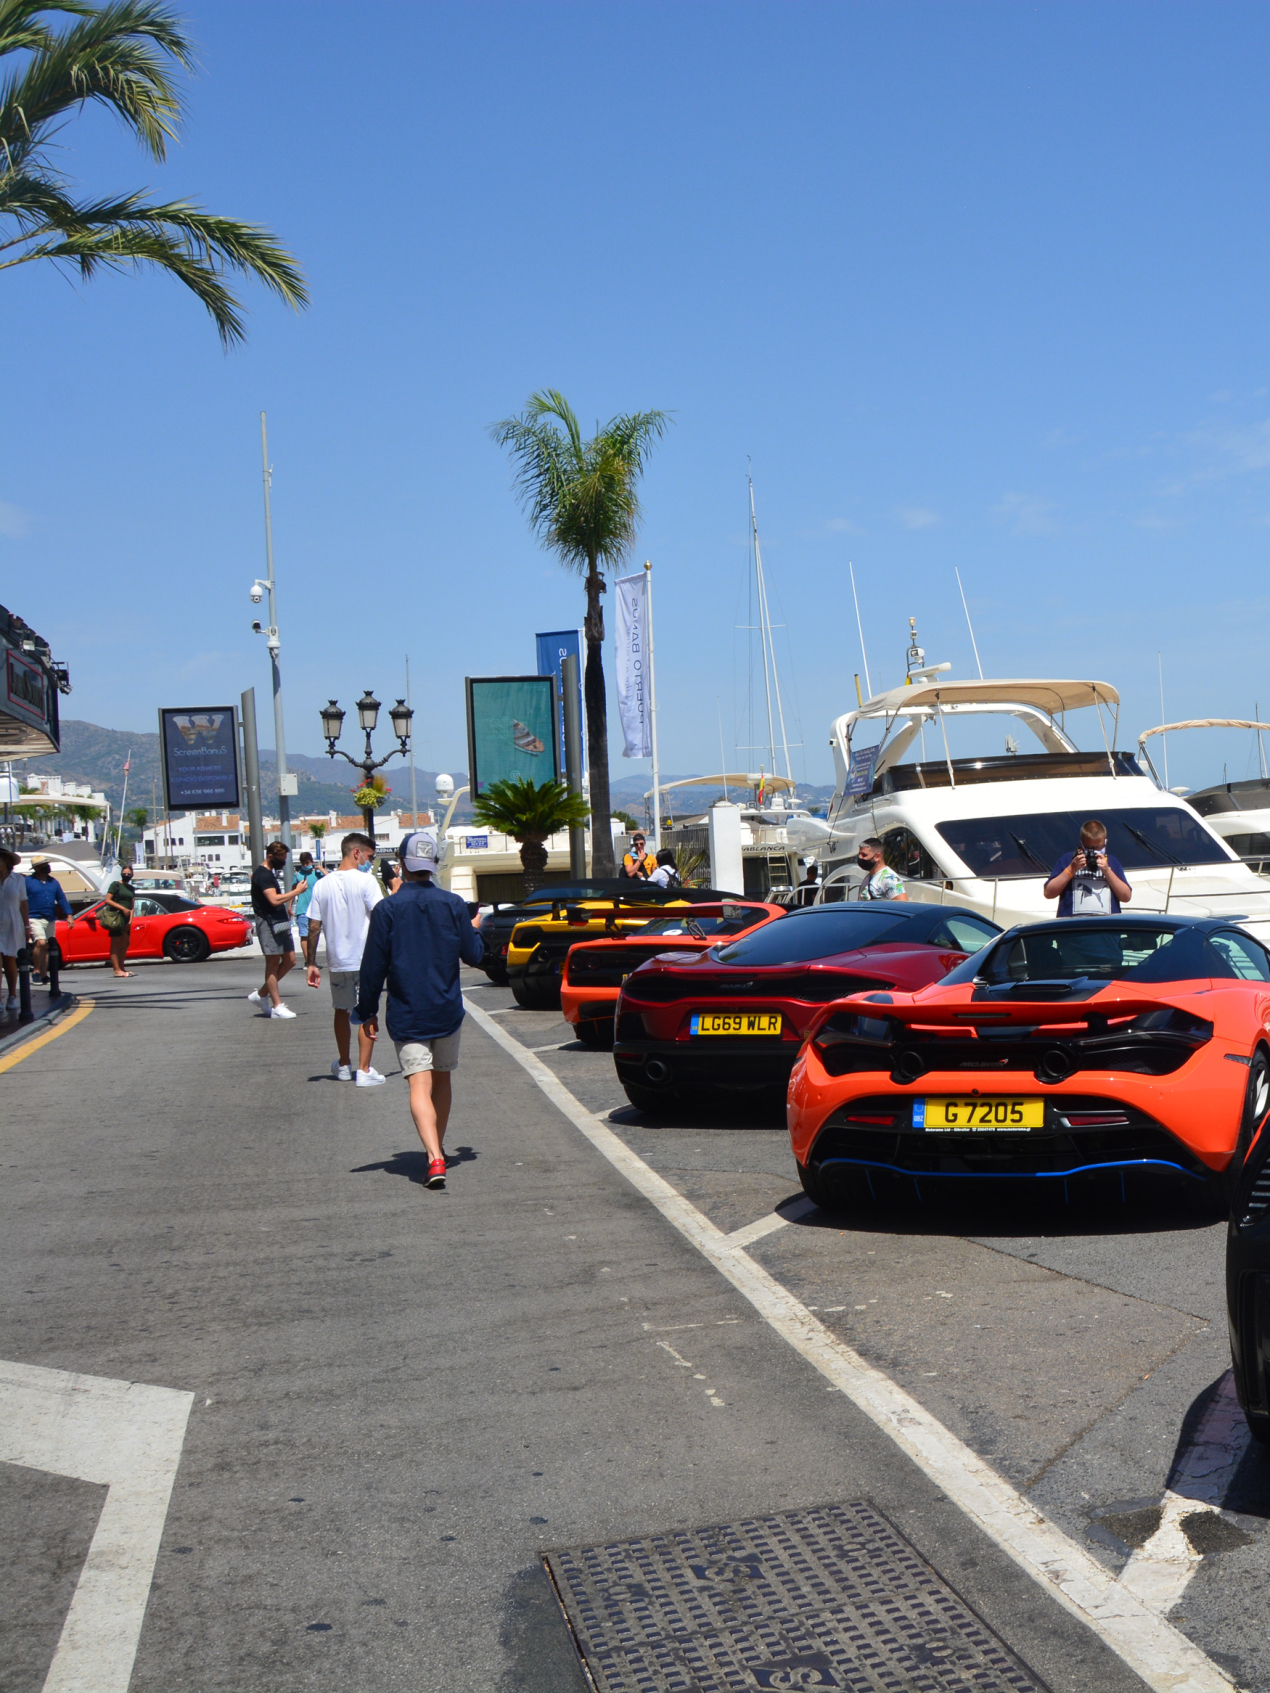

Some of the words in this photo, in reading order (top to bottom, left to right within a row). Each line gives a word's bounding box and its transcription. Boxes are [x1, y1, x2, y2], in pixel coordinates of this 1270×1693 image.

[173, 745, 227, 756] ScreenBanuS
[701, 1016, 742, 1031] LG69
[747, 1016, 778, 1031] WLR
[945, 1102, 958, 1124] G
[965, 1102, 1024, 1124] 7205
